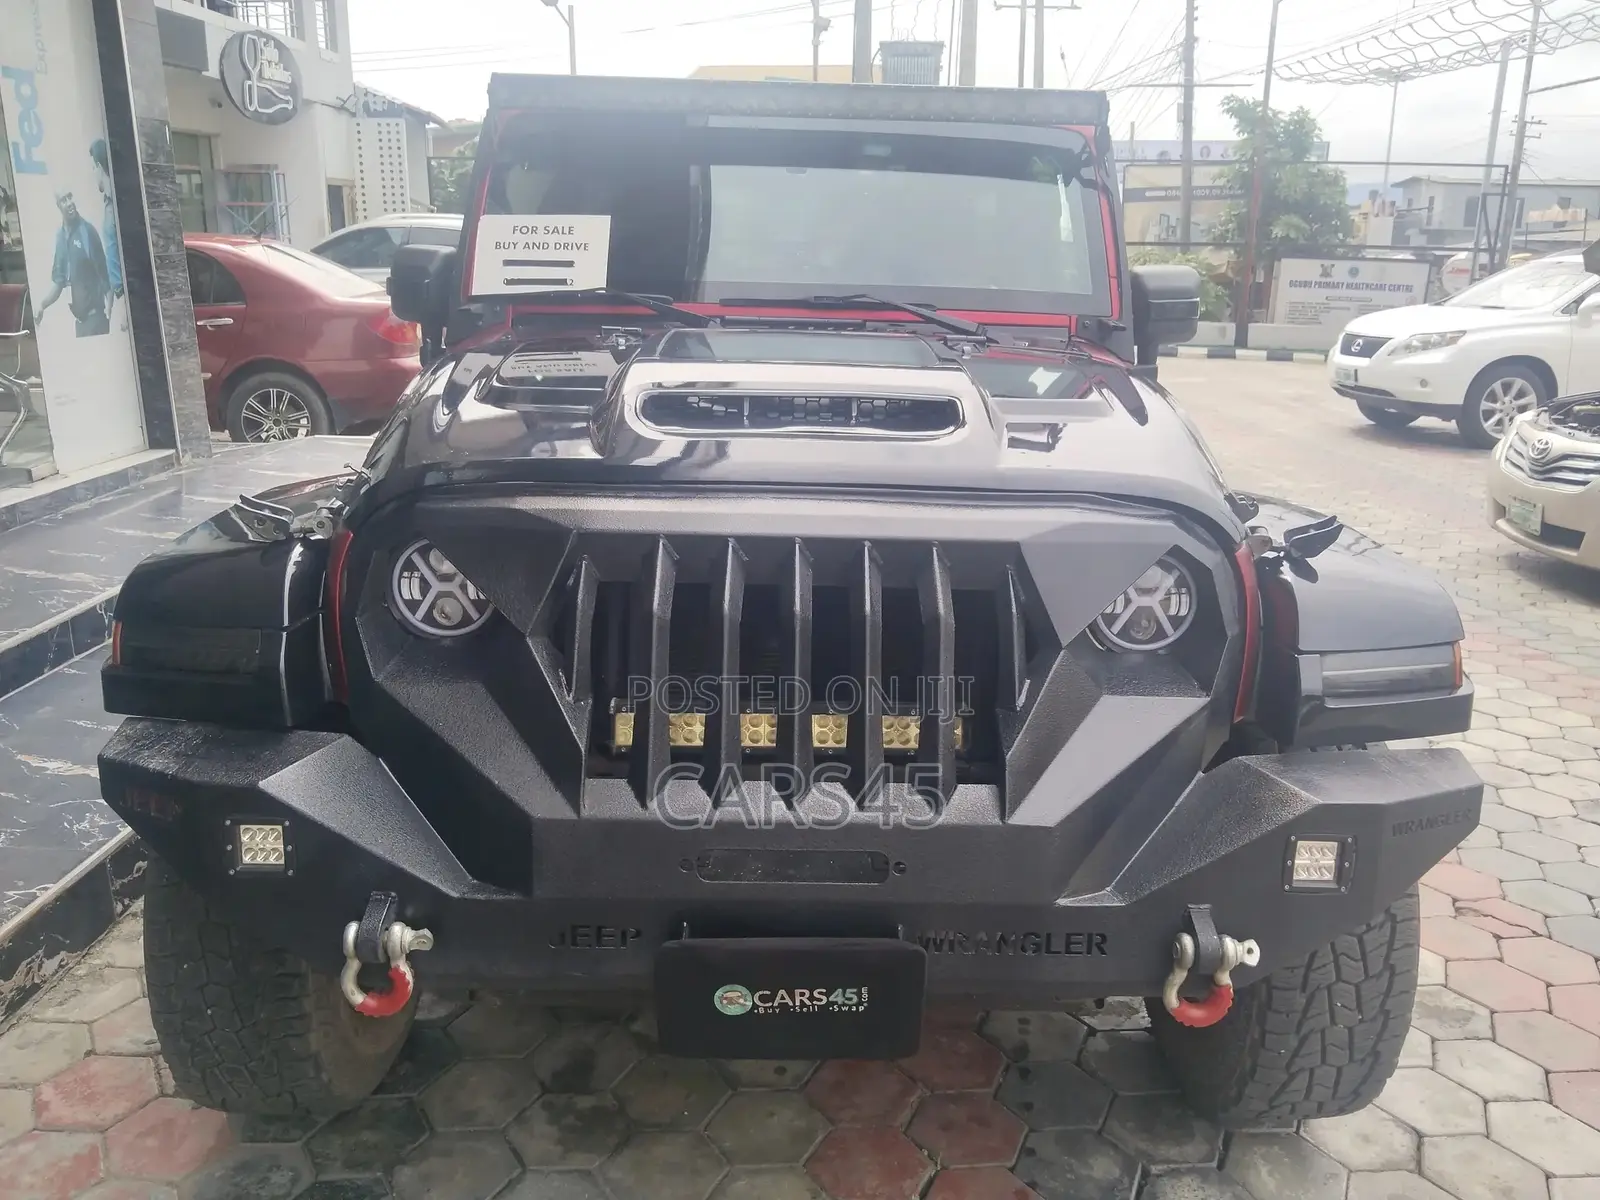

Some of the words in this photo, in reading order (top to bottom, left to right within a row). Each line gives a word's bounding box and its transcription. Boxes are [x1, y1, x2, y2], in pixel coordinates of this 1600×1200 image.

[1, 65, 49, 175] Fed
[512, 225, 538, 235] FOR
[543, 225, 575, 235] SALE
[494, 241, 519, 250] BUY
[522, 241, 550, 250] AND
[553, 242, 590, 251] DRIVE
[1313, 281, 1345, 290] PRIMARY
[1345, 281, 1387, 292] HEALTHCARE
[1387, 284, 1414, 293] CENTRE
[1391, 808, 1472, 837] WRANGLER
[548, 924, 642, 949] JEEP
[917, 931, 1108, 957] WRANGLER
[753, 988, 858, 1006] CARS45
